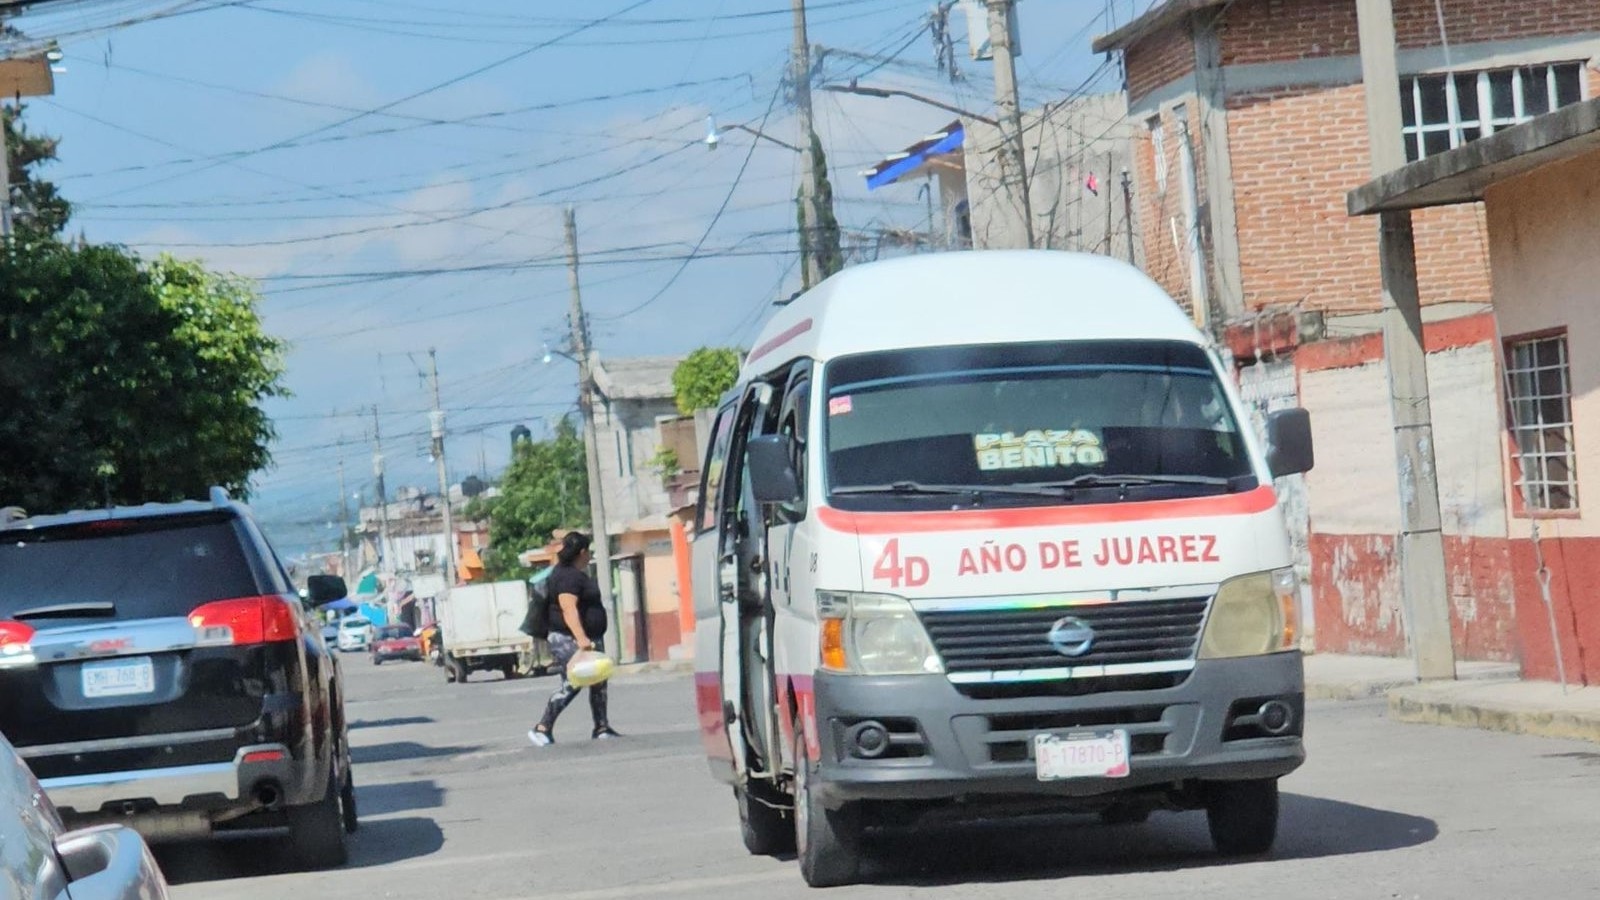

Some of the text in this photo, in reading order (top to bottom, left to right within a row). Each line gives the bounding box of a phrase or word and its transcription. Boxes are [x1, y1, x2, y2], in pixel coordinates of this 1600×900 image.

[975, 429, 1100, 451] PLAZA
[976, 445, 1105, 470] BENITO
[873, 535, 1220, 588] 4D AÑO DE JUAREZ
[1039, 743, 1123, 765] A-17870-P
